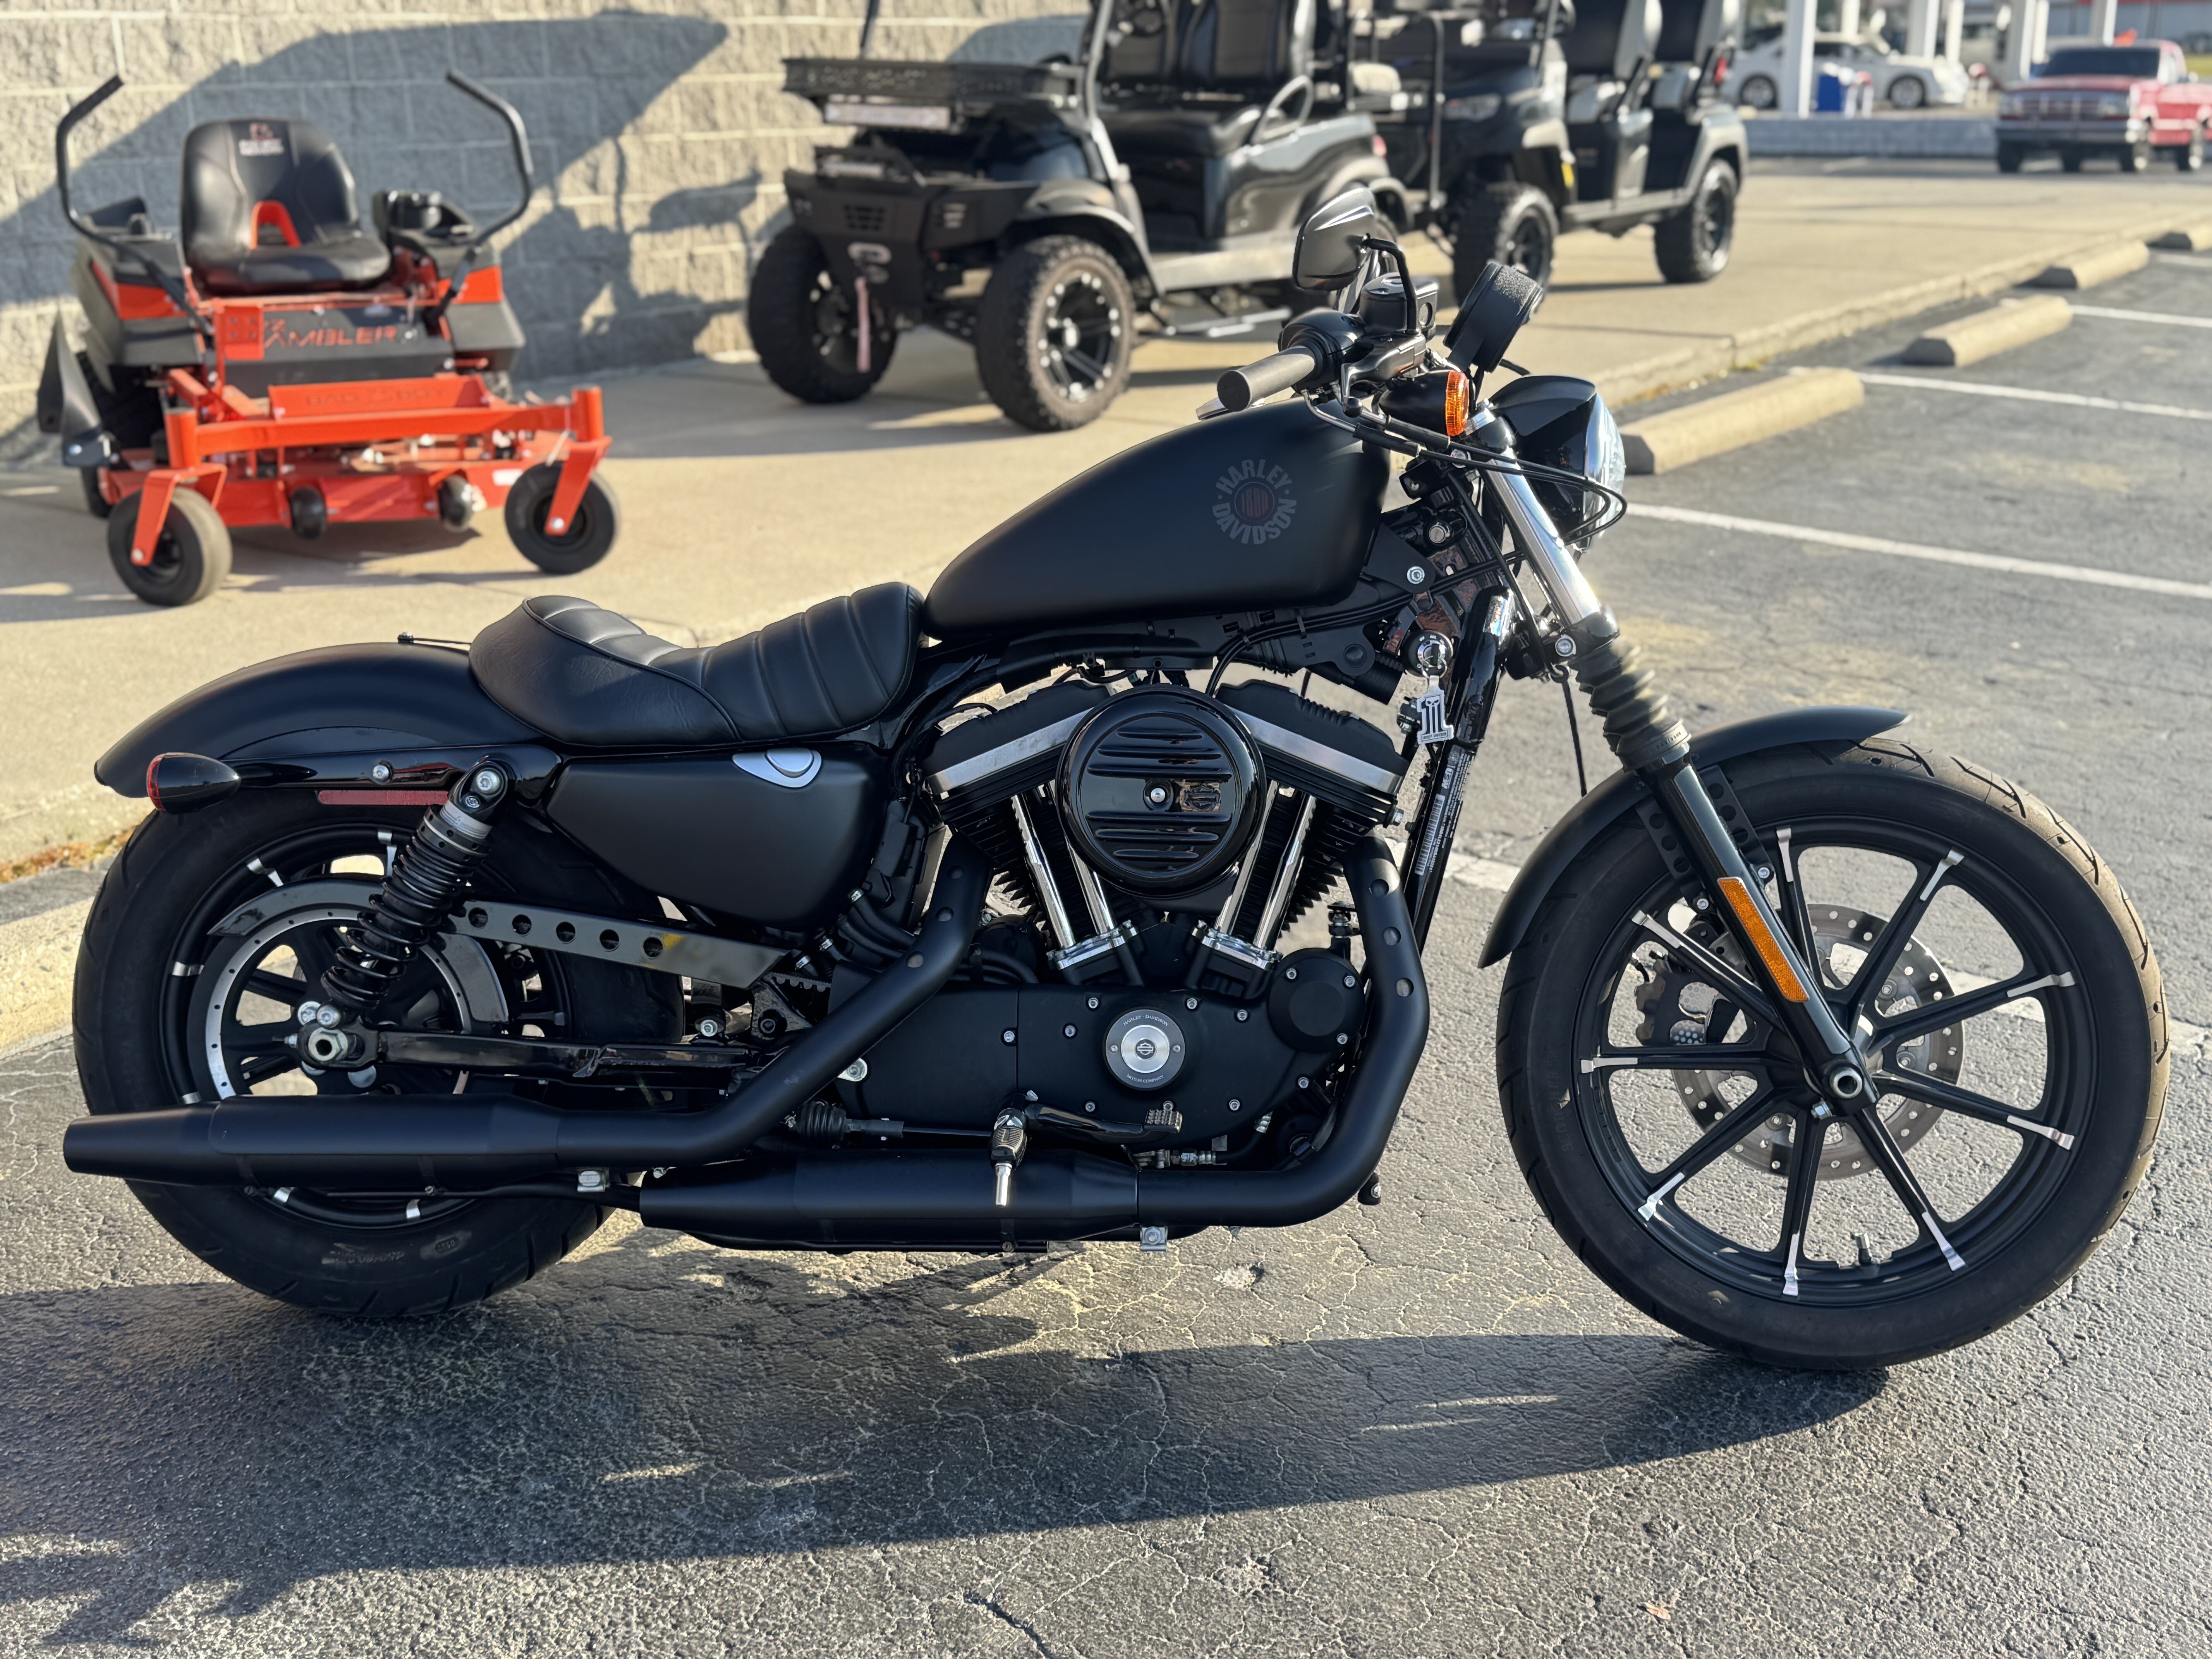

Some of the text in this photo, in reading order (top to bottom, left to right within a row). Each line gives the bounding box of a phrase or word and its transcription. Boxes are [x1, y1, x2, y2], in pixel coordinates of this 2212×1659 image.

[265, 325, 397, 348] AMBLER
[1215, 459, 1292, 495] HARLEY
[1212, 498, 1297, 545] DAVIDSON
[1123, 1015, 1142, 1026] HARLEY
[1145, 1014, 1169, 1027] DAVIDSON
[1126, 1073, 1164, 1083] MOTOR COMPANY
